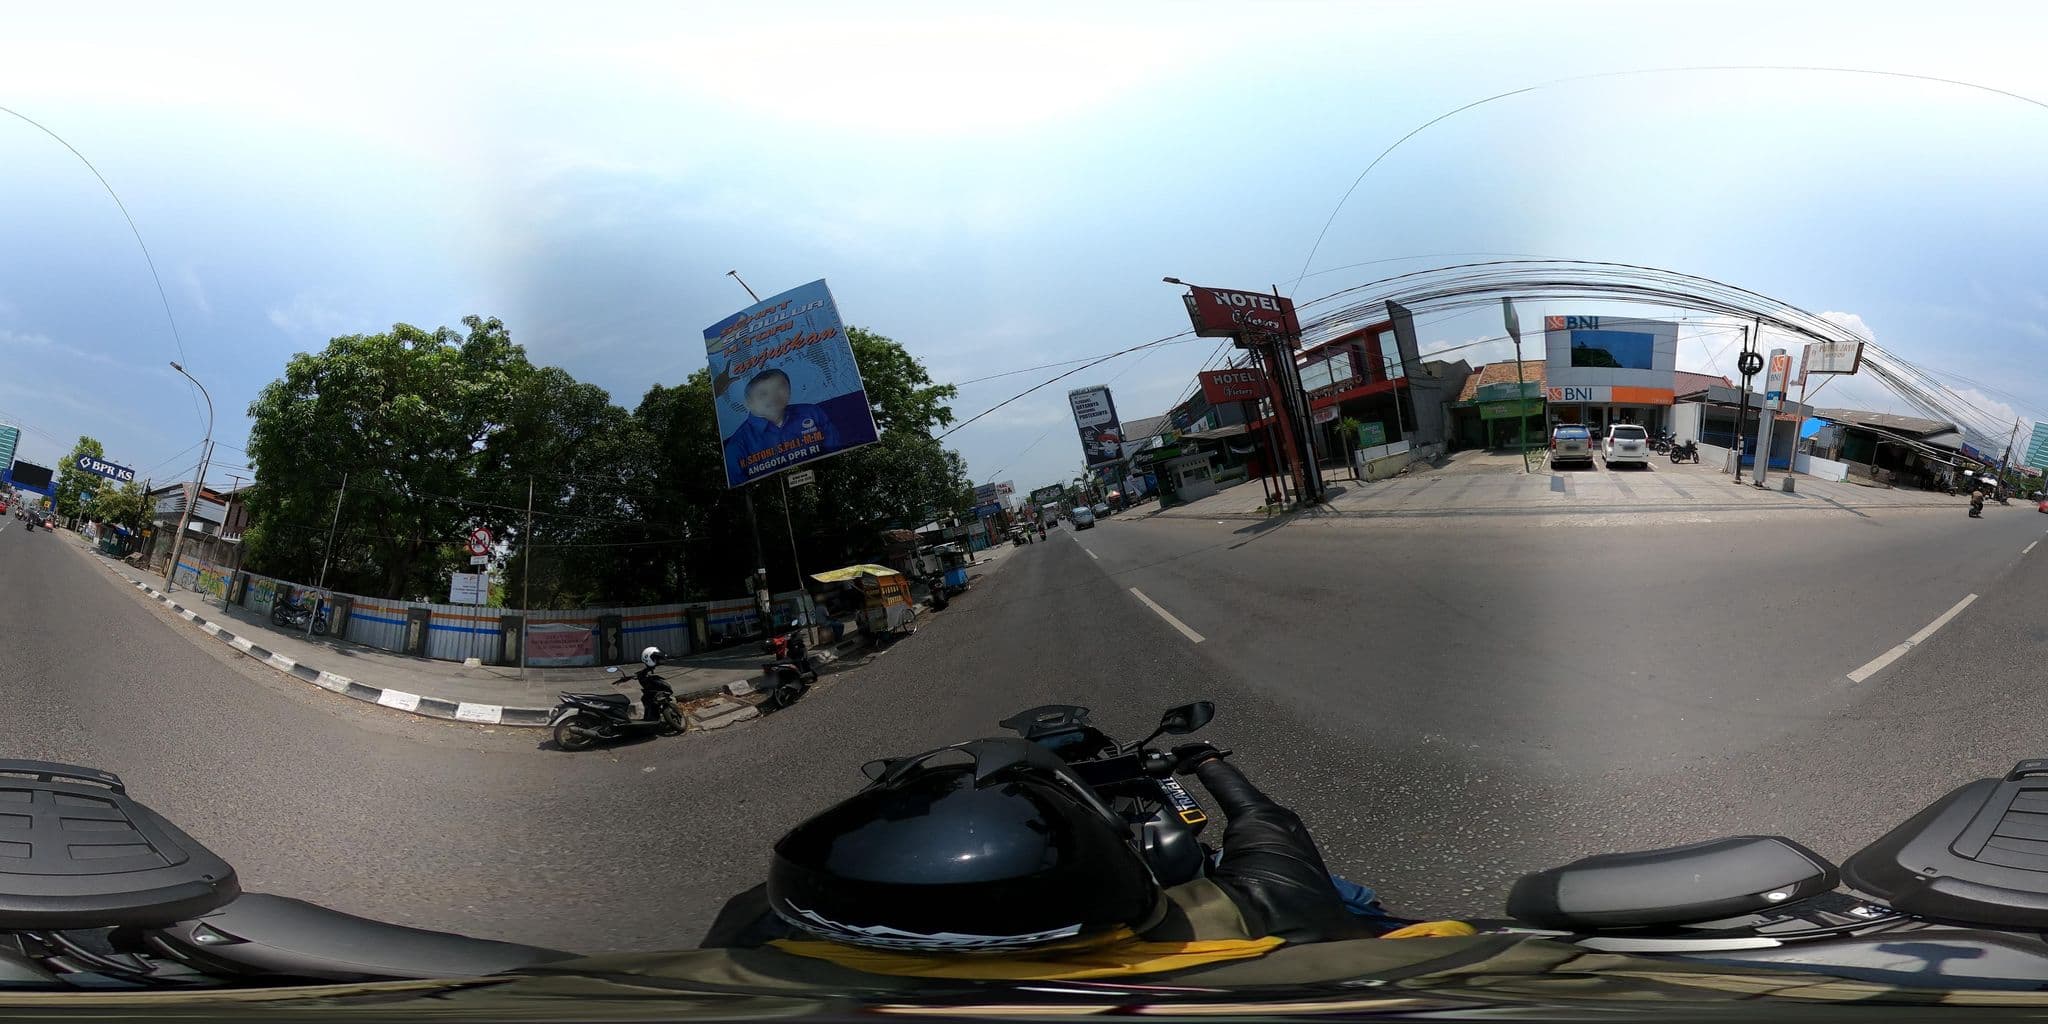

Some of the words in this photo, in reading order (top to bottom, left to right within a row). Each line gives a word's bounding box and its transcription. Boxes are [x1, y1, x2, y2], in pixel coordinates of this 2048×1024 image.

[1214, 291, 1280, 311] HOTEL
[1566, 316, 1600, 330] BNI
[1213, 372, 1256, 385] HOTEL
[1565, 387, 1592, 401] BNI
[748, 455, 787, 475] ANGGOTA
[788, 449, 807, 461] DPR
[809, 444, 820, 454] RI
[92, 461, 115, 475] BPR
[117, 469, 133, 480] KS
